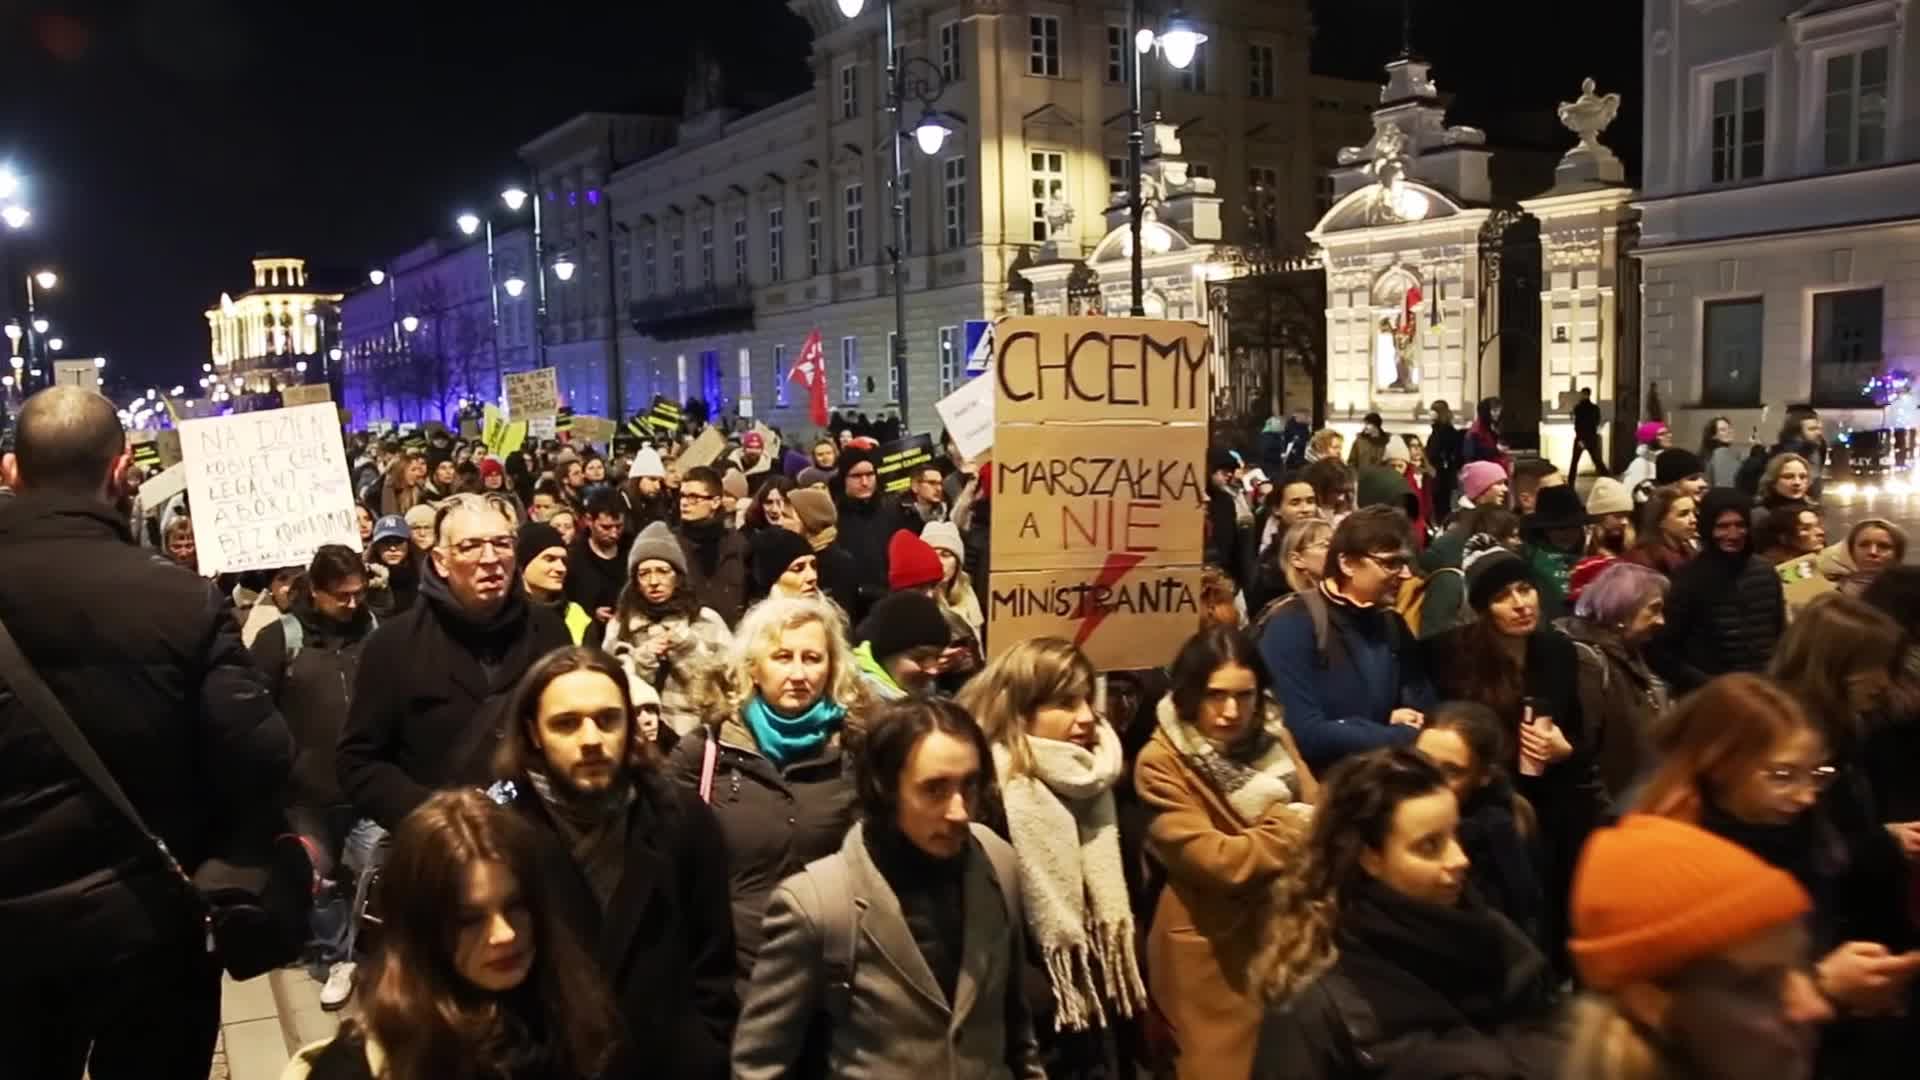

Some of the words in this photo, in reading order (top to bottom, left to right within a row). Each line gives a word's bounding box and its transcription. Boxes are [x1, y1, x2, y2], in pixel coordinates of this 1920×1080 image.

[997, 331, 1211, 410] CHCEMY
[201, 424, 239, 452] NA
[998, 458, 1205, 508] MARSZAŁKĄ
[1018, 511, 1041, 539] A
[1062, 499, 1162, 553] NIE
